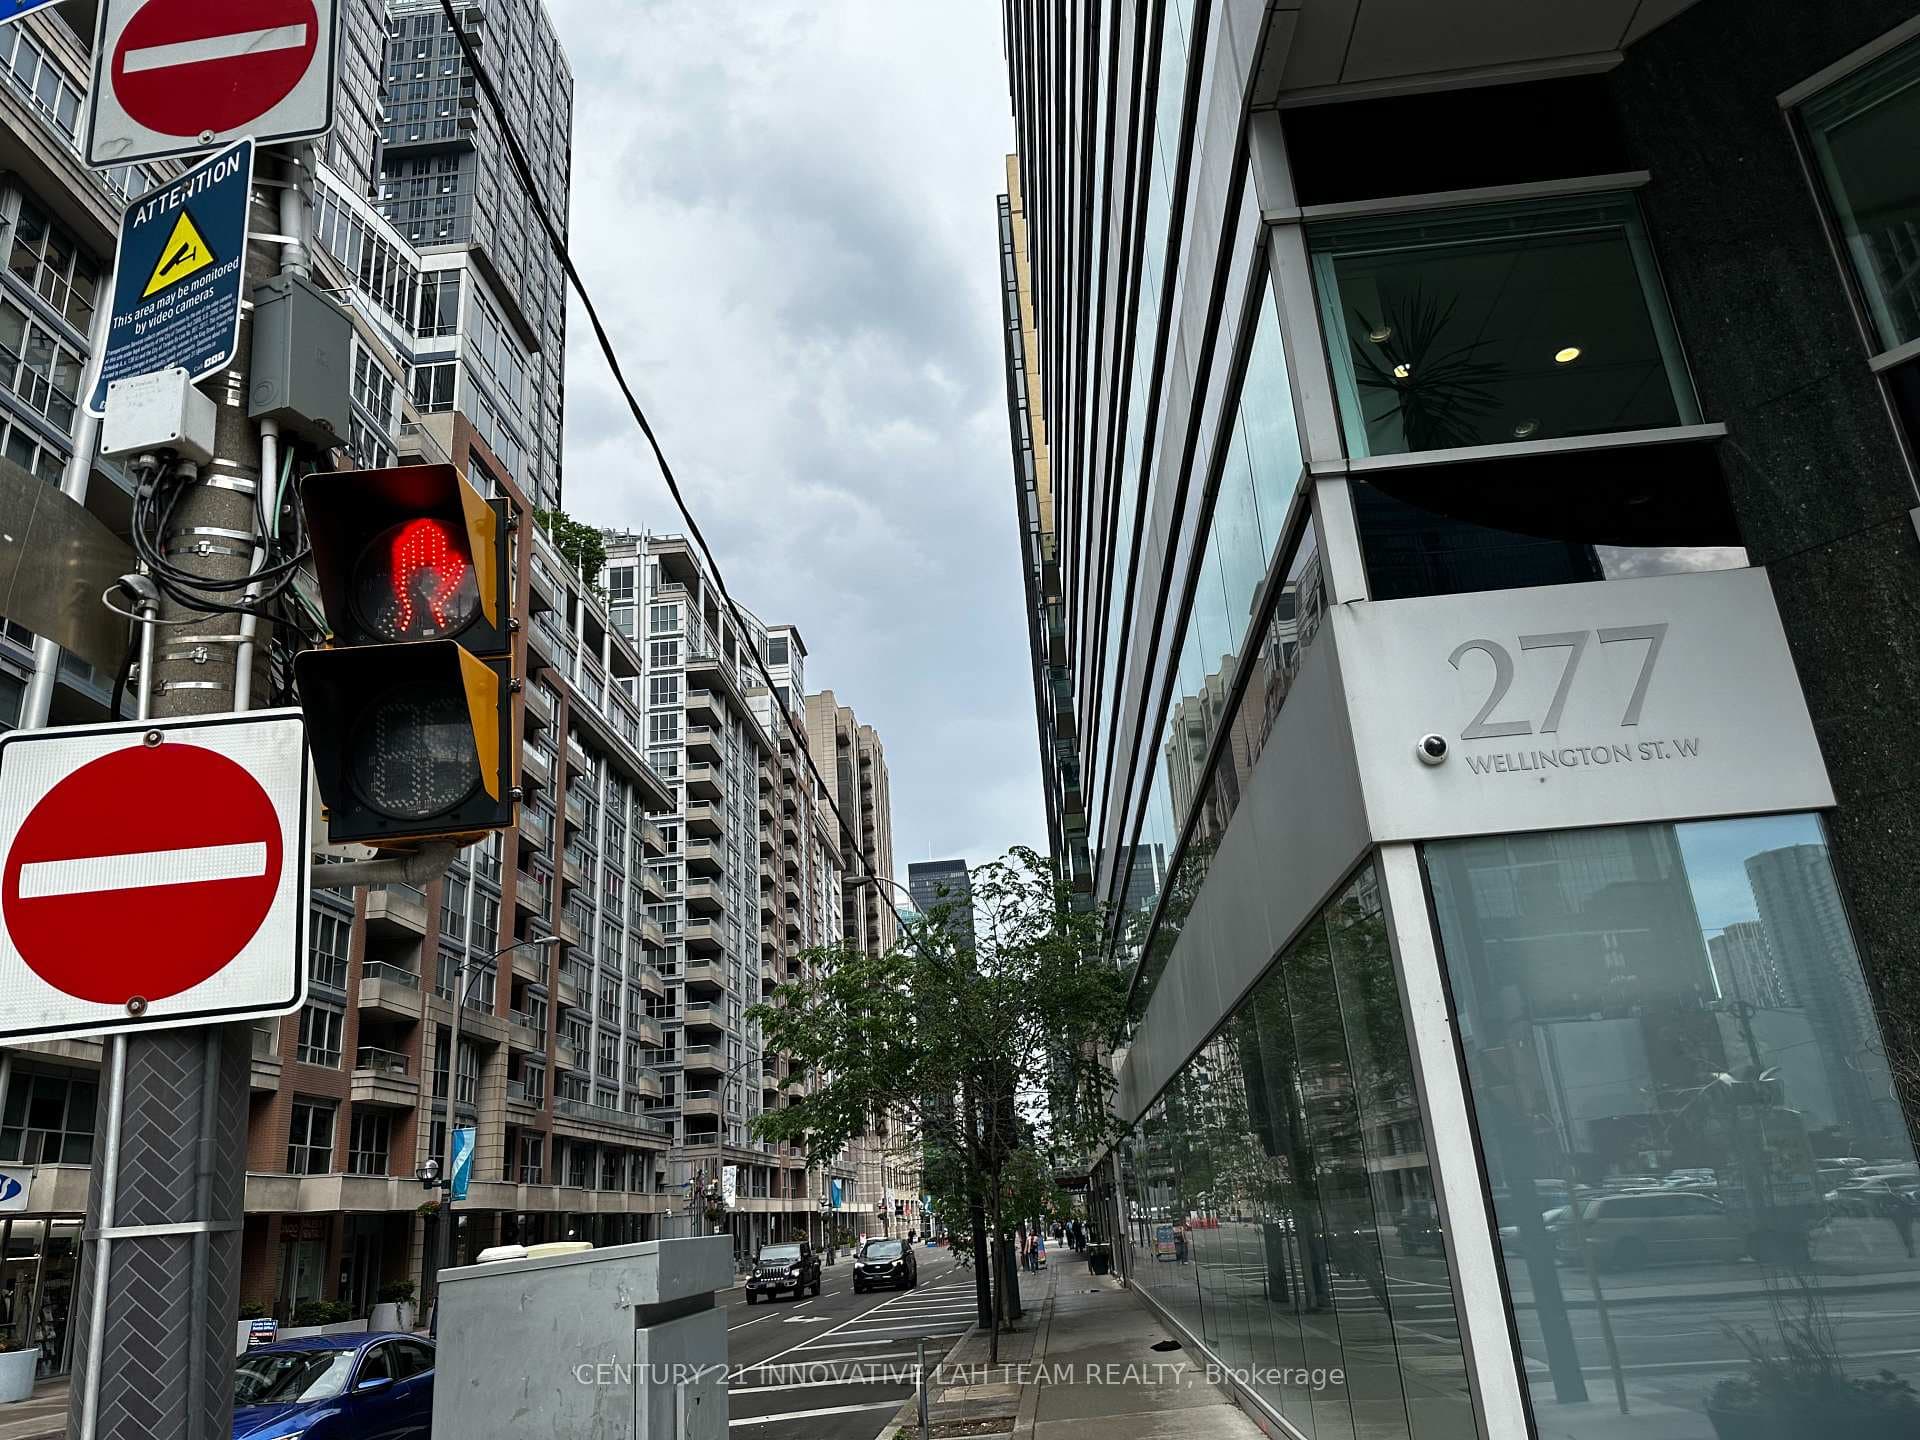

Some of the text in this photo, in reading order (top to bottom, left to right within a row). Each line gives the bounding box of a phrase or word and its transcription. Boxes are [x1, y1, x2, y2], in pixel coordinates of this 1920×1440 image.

[133, 151, 240, 228] ATTENTION
[113, 255, 240, 329] This area may be monitored
[135, 286, 214, 335] by video cameras
[1448, 623, 1669, 740] 277
[1465, 743, 1633, 775] WELLINGTON
